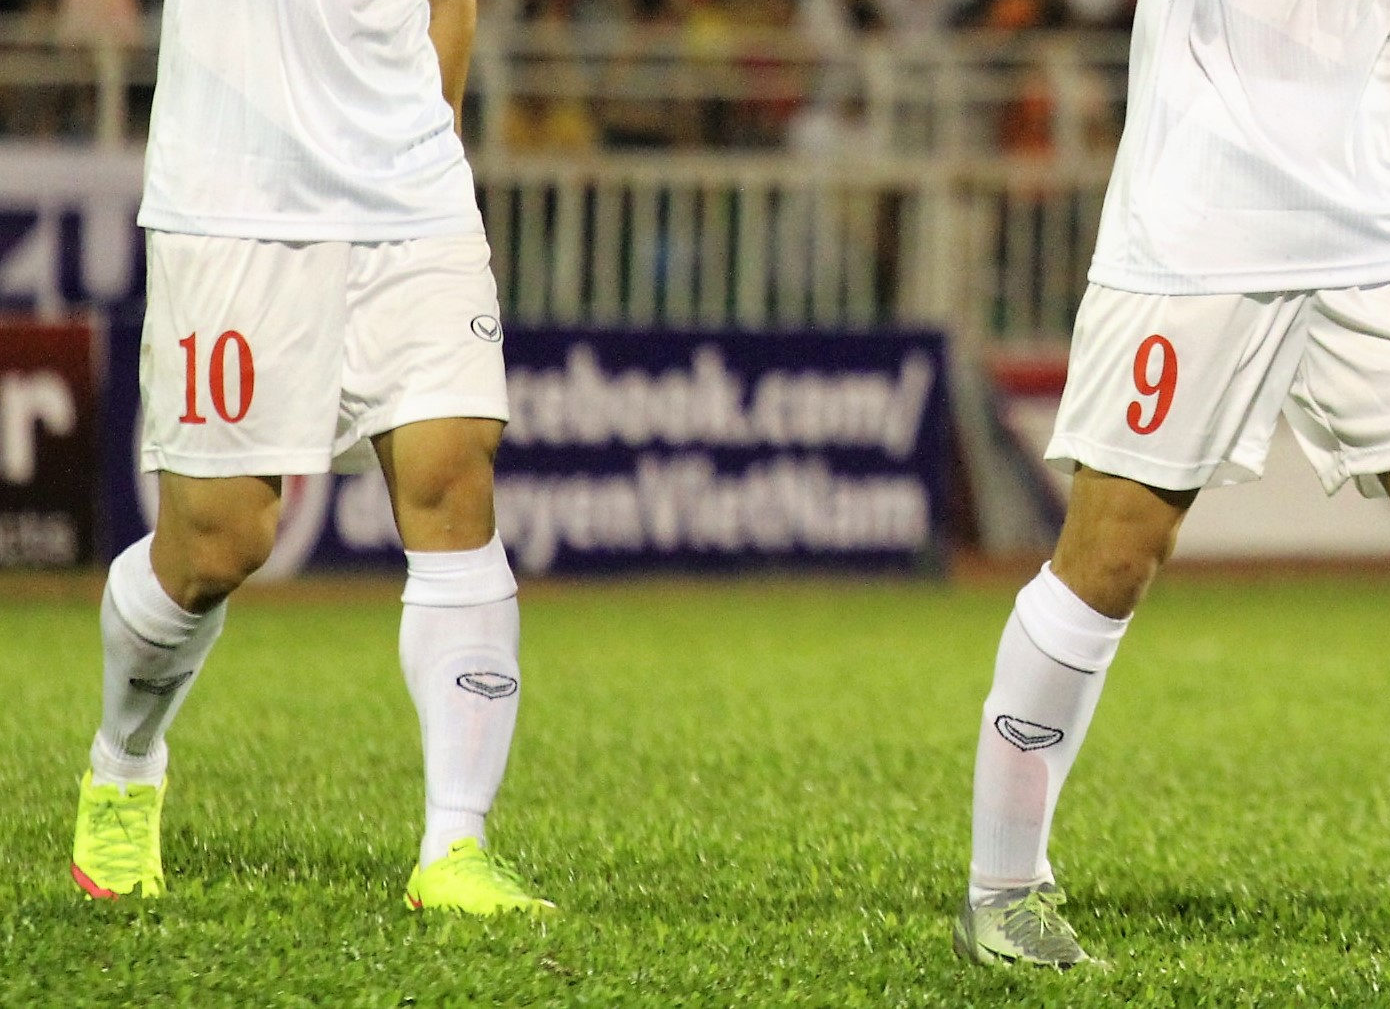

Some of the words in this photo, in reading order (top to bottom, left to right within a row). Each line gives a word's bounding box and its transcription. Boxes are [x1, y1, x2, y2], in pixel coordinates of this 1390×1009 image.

[179, 330, 255, 424] 10
[504, 341, 934, 462] cebook.com/
[1126, 334, 1178, 436] 9
